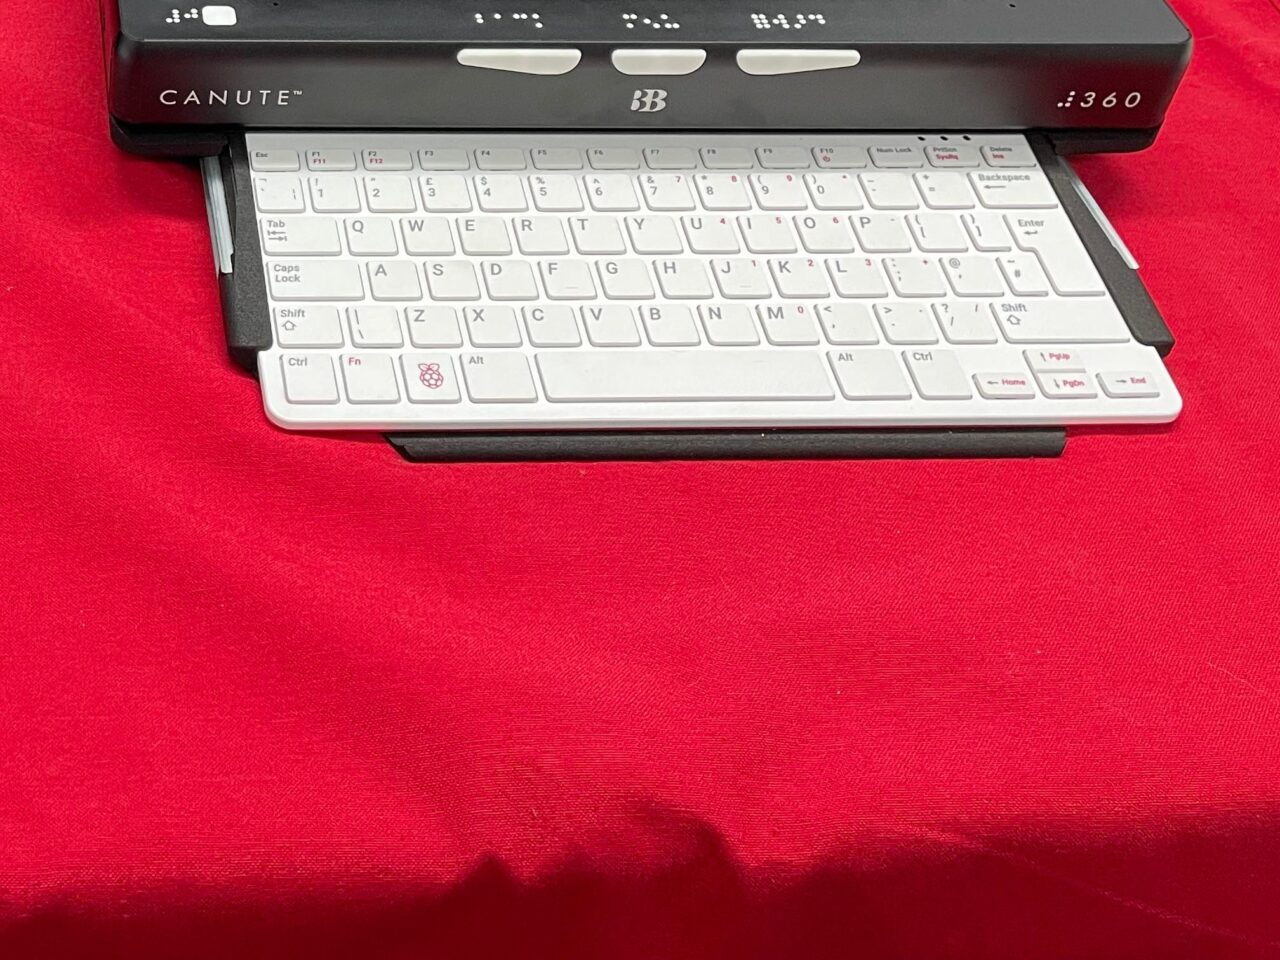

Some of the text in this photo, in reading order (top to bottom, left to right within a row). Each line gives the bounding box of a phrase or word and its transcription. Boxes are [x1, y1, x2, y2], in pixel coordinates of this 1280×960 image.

[352, 220, 364, 233] Q
[408, 220, 424, 232] W
[465, 220, 475, 231] E
[522, 219, 532, 231] R
[577, 219, 588, 230] T
[634, 218, 644, 230] Y
[691, 218, 702, 229] U
[804, 217, 816, 229] O
[860, 217, 871, 228] P
[274, 264, 299, 273] Caps
[375, 264, 387, 276] A
[433, 264, 443, 276] S
[491, 263, 502, 275] D
[548, 263, 557, 275] F
[606, 262, 618, 274] G
[664, 262, 676, 274] H
[721, 261, 730, 273] J
[778, 261, 791, 273] K
[836, 261, 847, 272] L
[414, 309, 425, 322] Z
[473, 309, 485, 321] X
[532, 308, 544, 321] C
[590, 308, 602, 320] V
[650, 308, 661, 320] B
[708, 307, 721, 319] N
[767, 307, 784, 319] M
[288, 357, 307, 366] Ctrl
